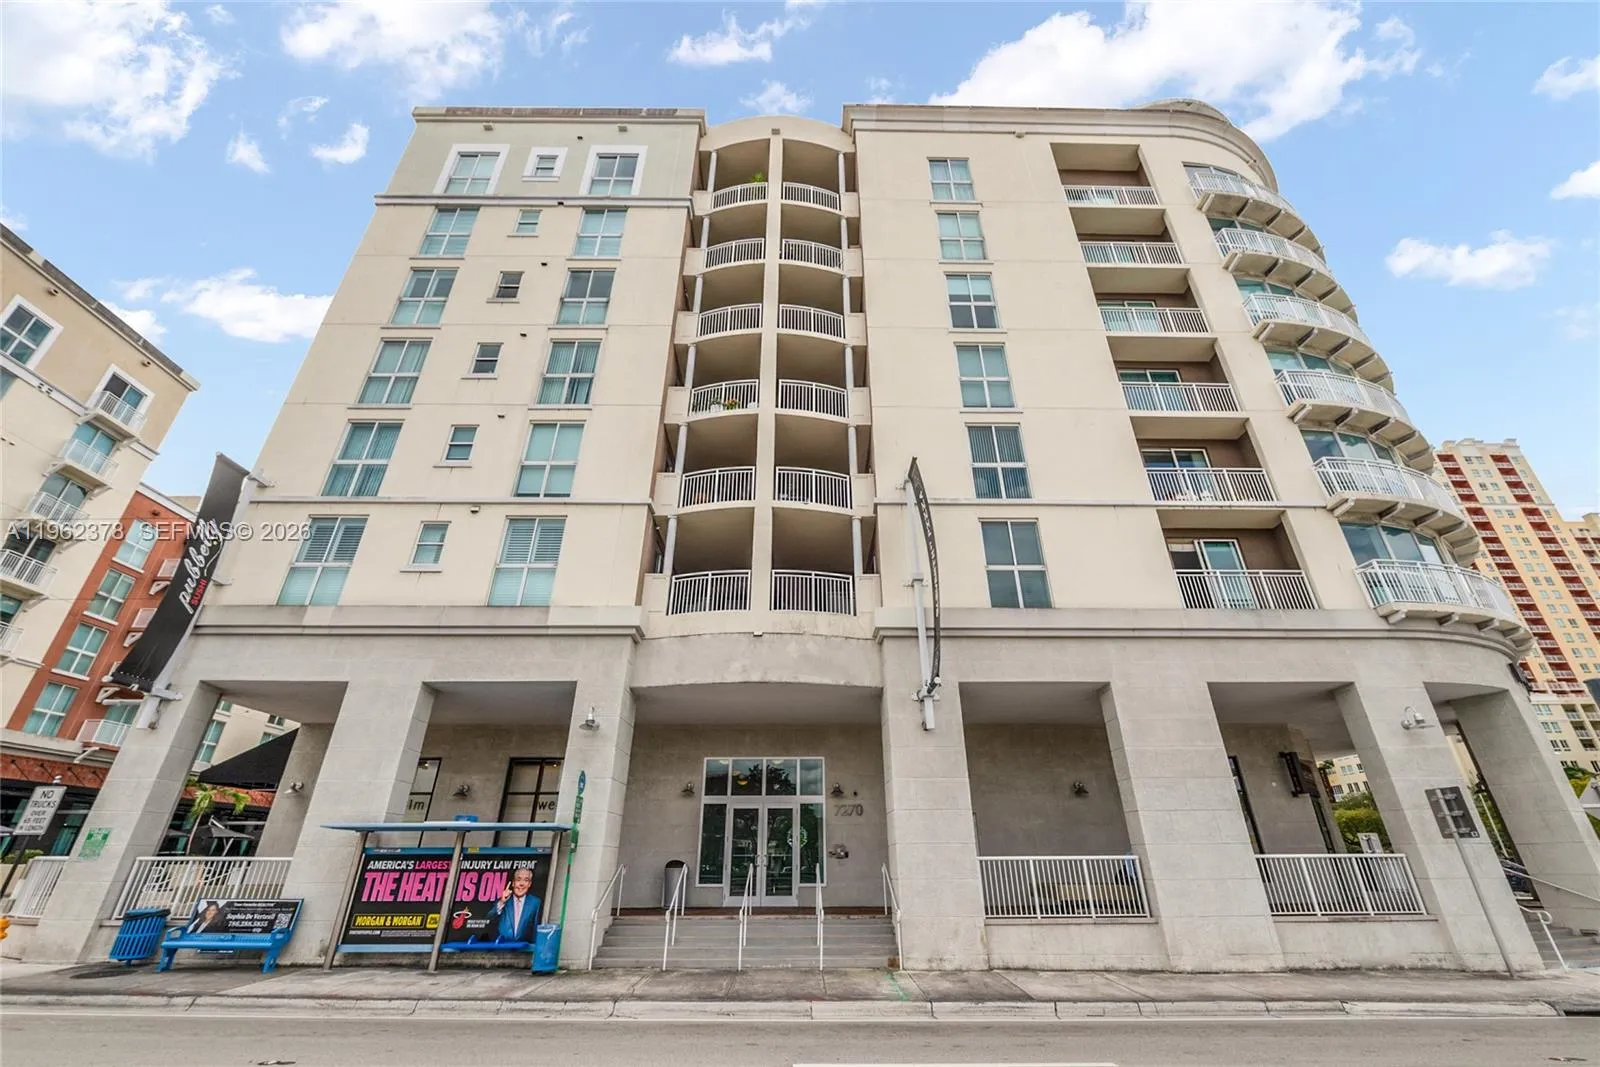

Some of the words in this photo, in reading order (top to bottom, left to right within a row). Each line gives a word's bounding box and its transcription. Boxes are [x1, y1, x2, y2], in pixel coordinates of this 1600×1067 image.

[191, 579, 208, 606] SUSHI
[40, 790, 55, 799] NO
[30, 800, 57, 809] TRUCKS
[833, 803, 864, 817] 7270
[366, 860, 415, 870] AMERICA'S
[460, 860, 493, 870] INJURY
[493, 860, 514, 870] LAW
[361, 872, 400, 902] THE
[397, 872, 448, 902] HEAT
[455, 871, 478, 902] IS
[478, 871, 508, 902] ON
[355, 916, 386, 927] MORGAN
[391, 916, 423, 927] MORGAN
